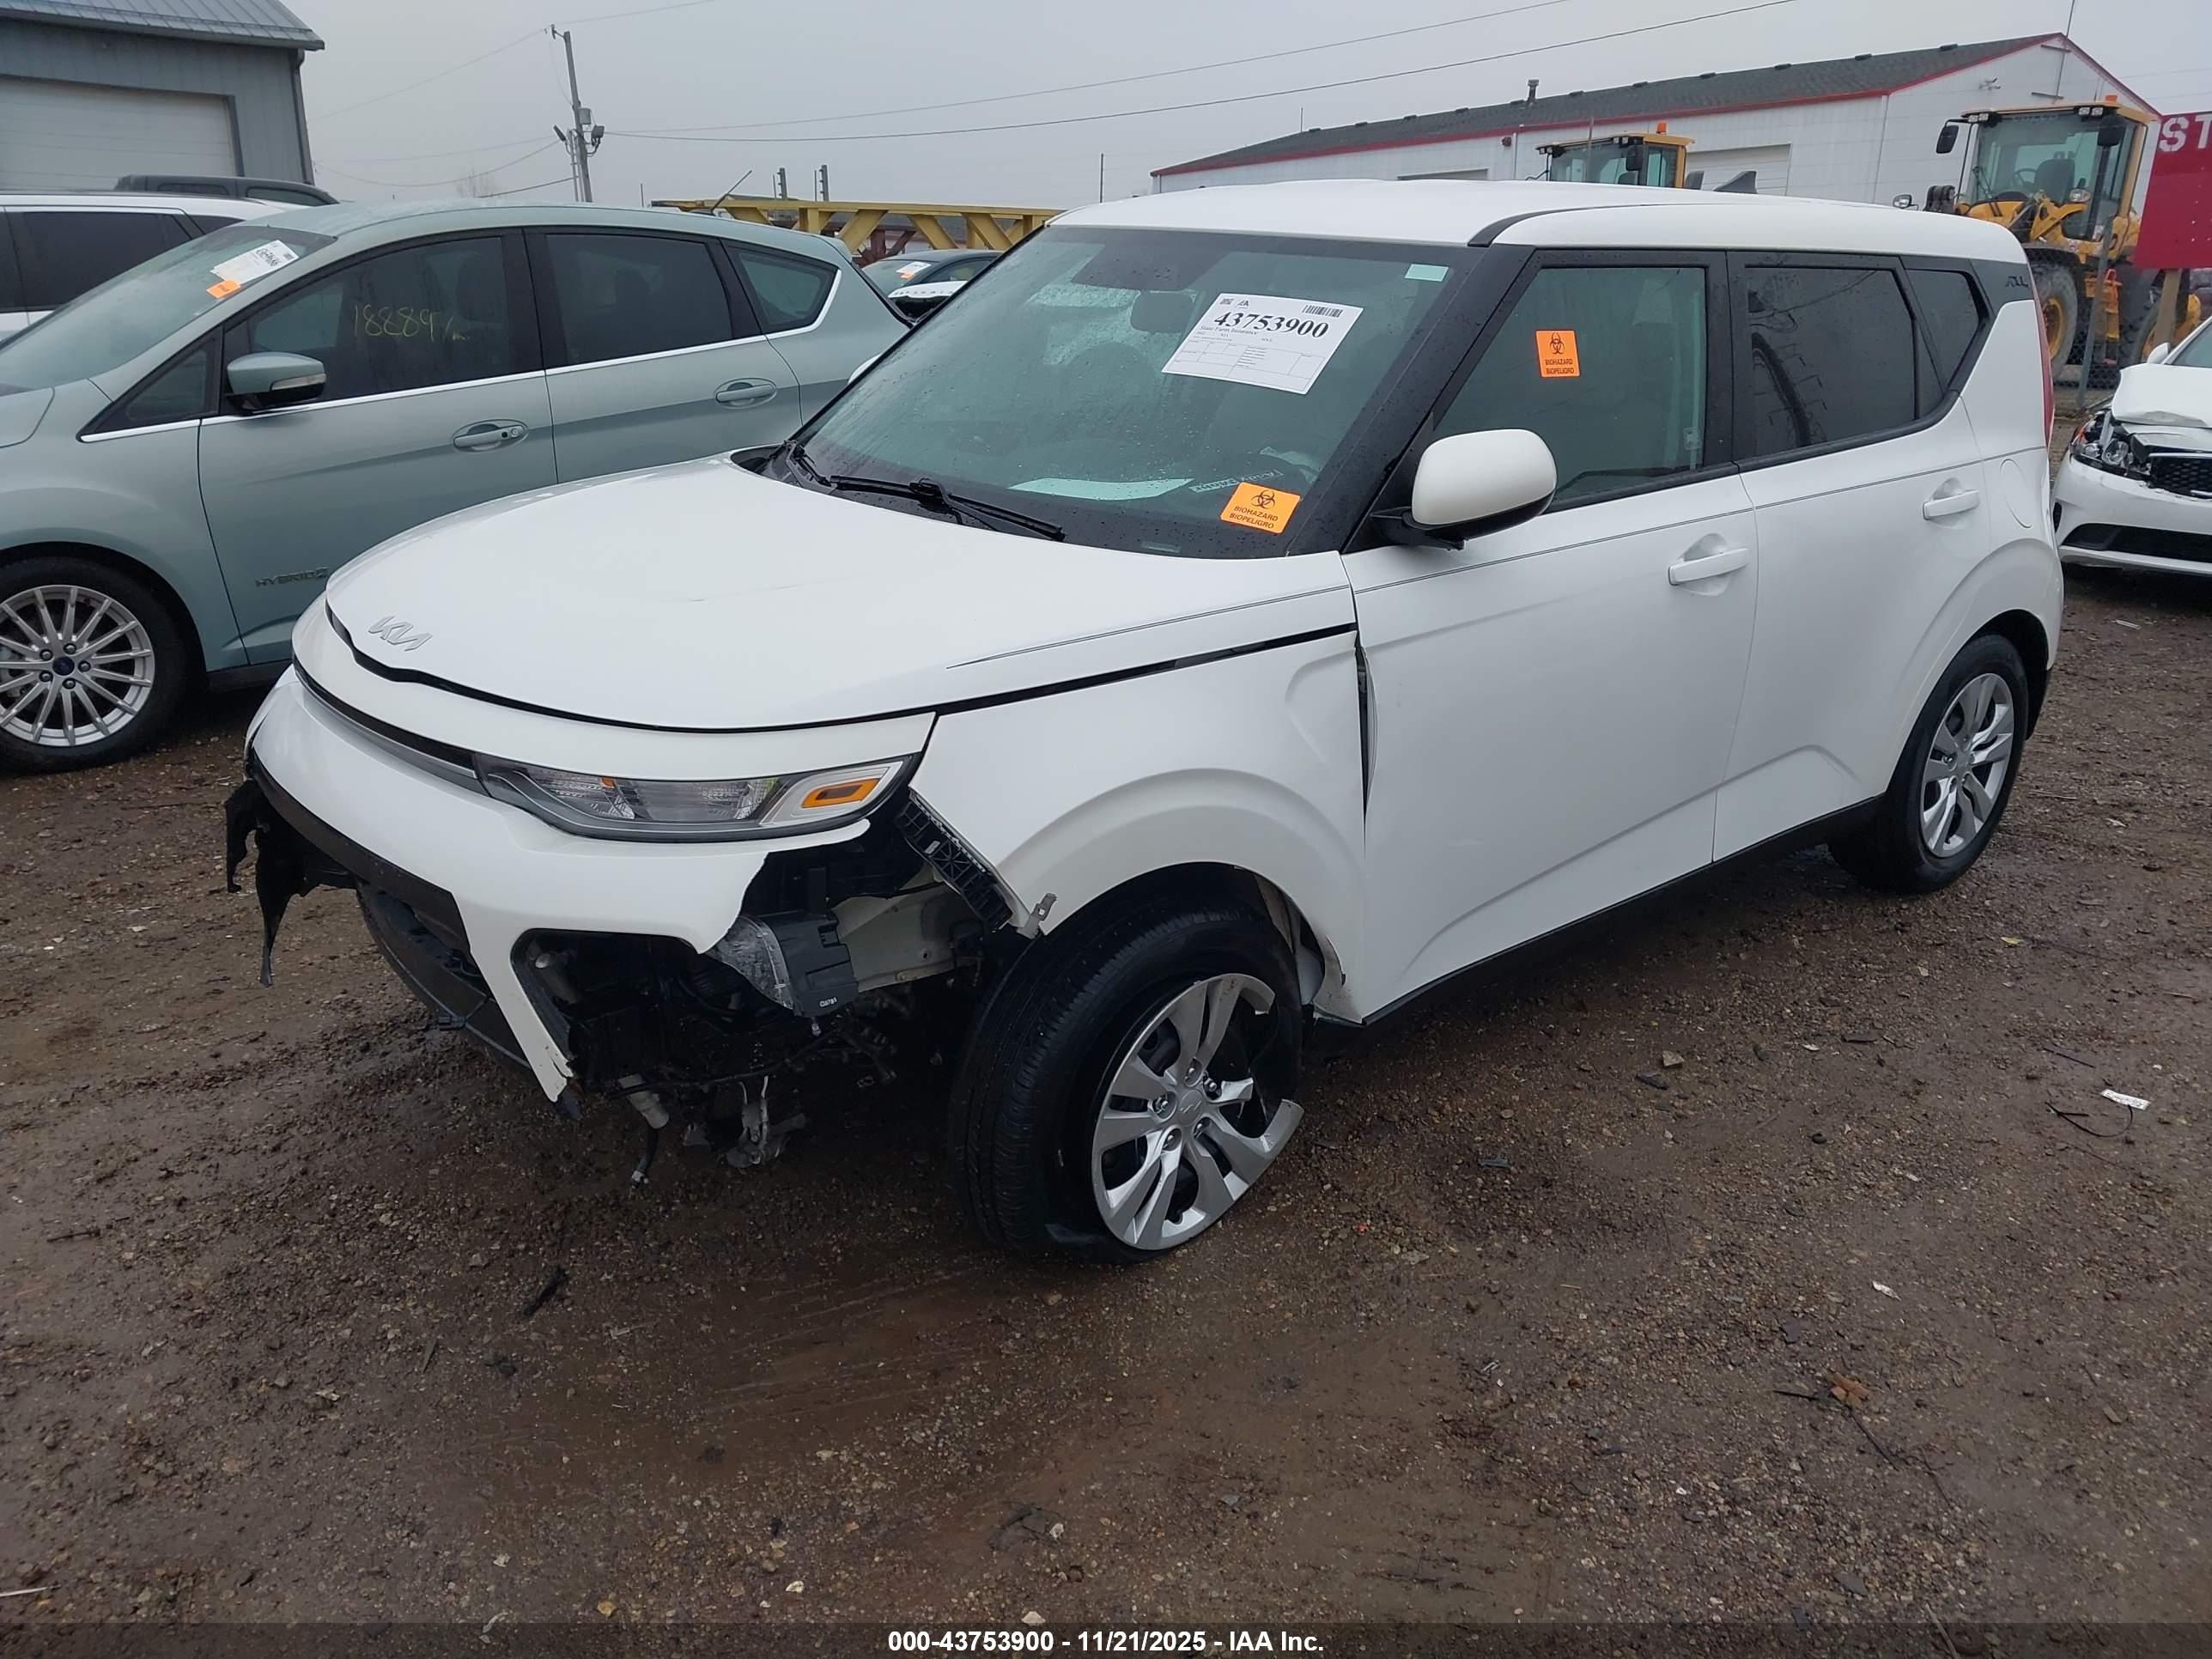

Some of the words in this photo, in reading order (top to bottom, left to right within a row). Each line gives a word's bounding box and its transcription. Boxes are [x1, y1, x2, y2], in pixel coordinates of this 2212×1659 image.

[1214, 311, 1329, 337] 43753900
[1229, 512, 1274, 529] BIOPELIGRO
[1233, 505, 1279, 522] BIOHAZARD
[368, 616, 434, 652] KIA
